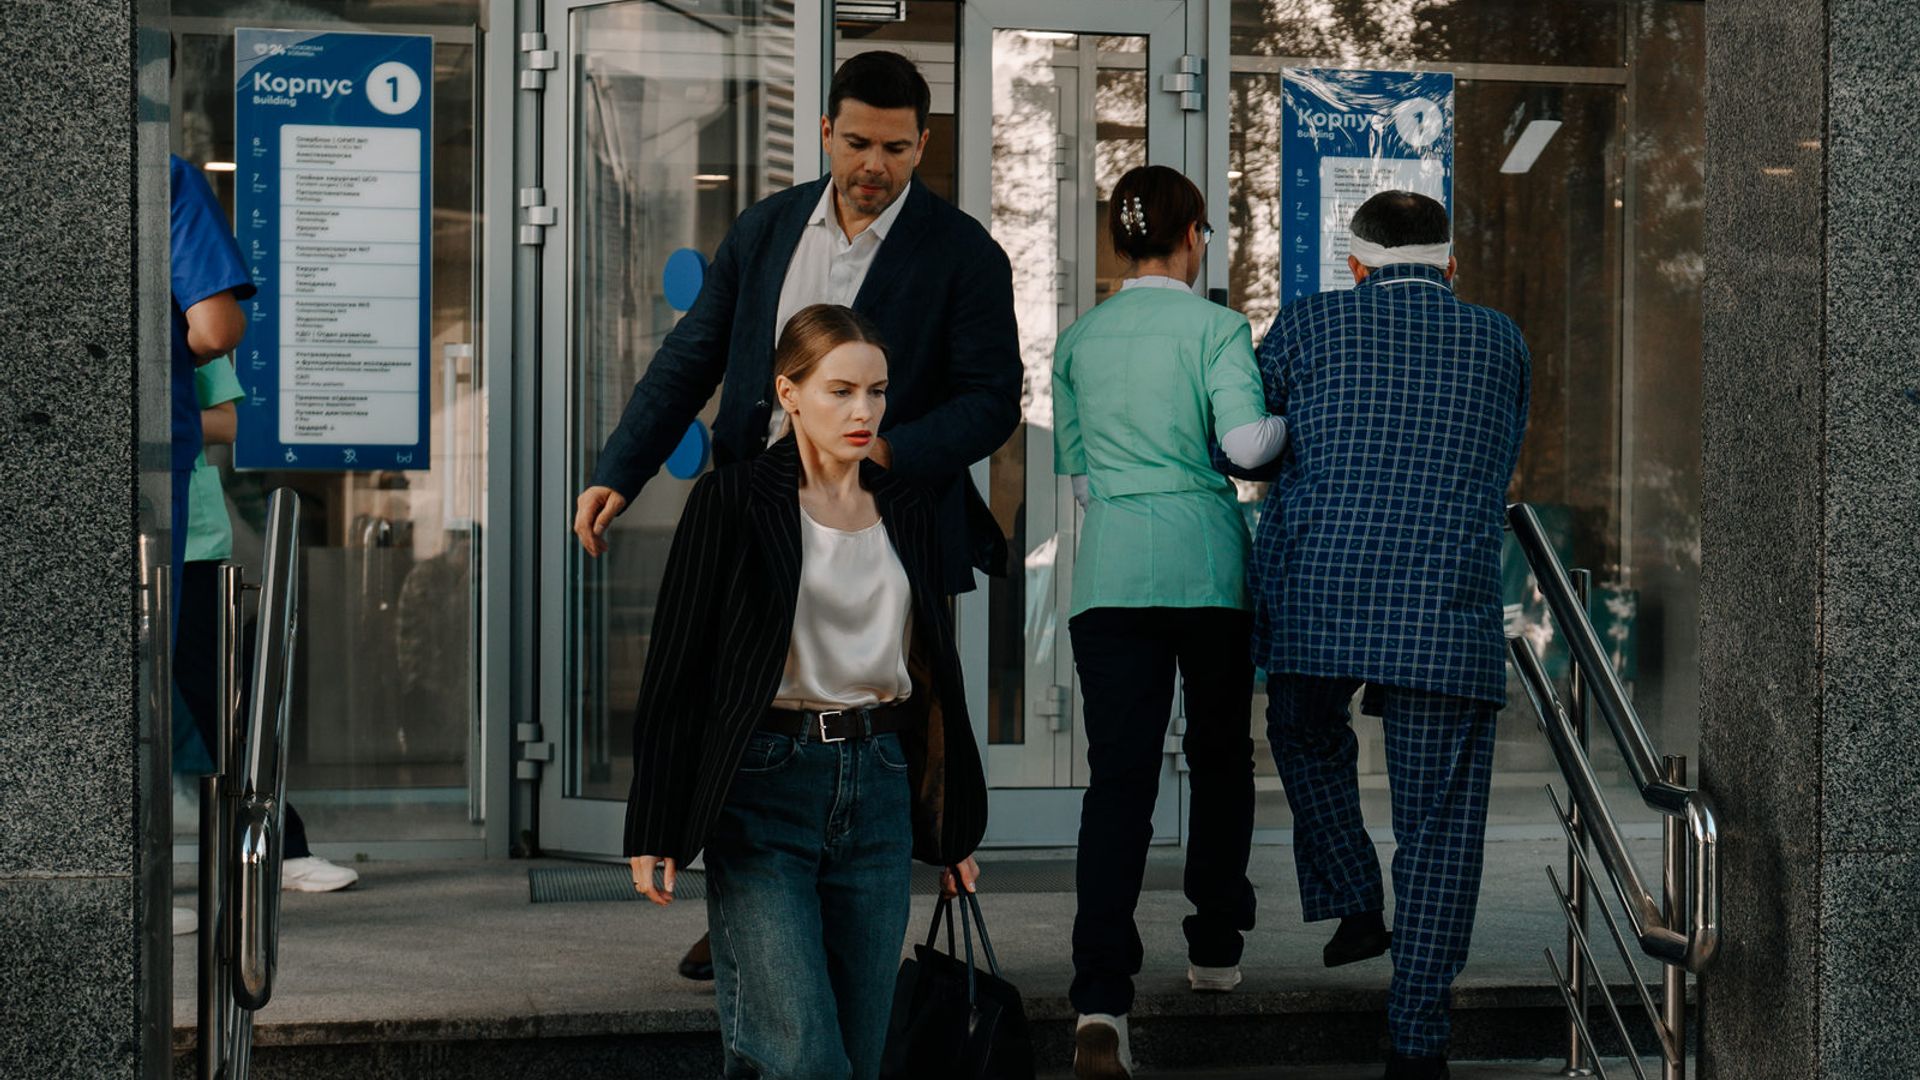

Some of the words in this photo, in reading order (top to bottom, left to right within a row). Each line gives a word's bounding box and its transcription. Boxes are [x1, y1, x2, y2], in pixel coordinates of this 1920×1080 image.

[254, 71, 353, 99] Корпус
[386, 76, 399, 103] 1
[253, 95, 297, 108] Building
[1297, 130, 1335, 140] Buding
[1296, 168, 1303, 177] 8
[253, 173, 260, 182] 7
[1296, 202, 1303, 210] 7
[252, 209, 260, 217] 6
[1296, 235, 1303, 243] 6
[252, 240, 260, 249] 5
[252, 266, 260, 275] 4
[1296, 263, 1303, 273] 5
[1296, 289, 1302, 297] 4
[252, 350, 259, 359] 2
[252, 386, 258, 395] 1
